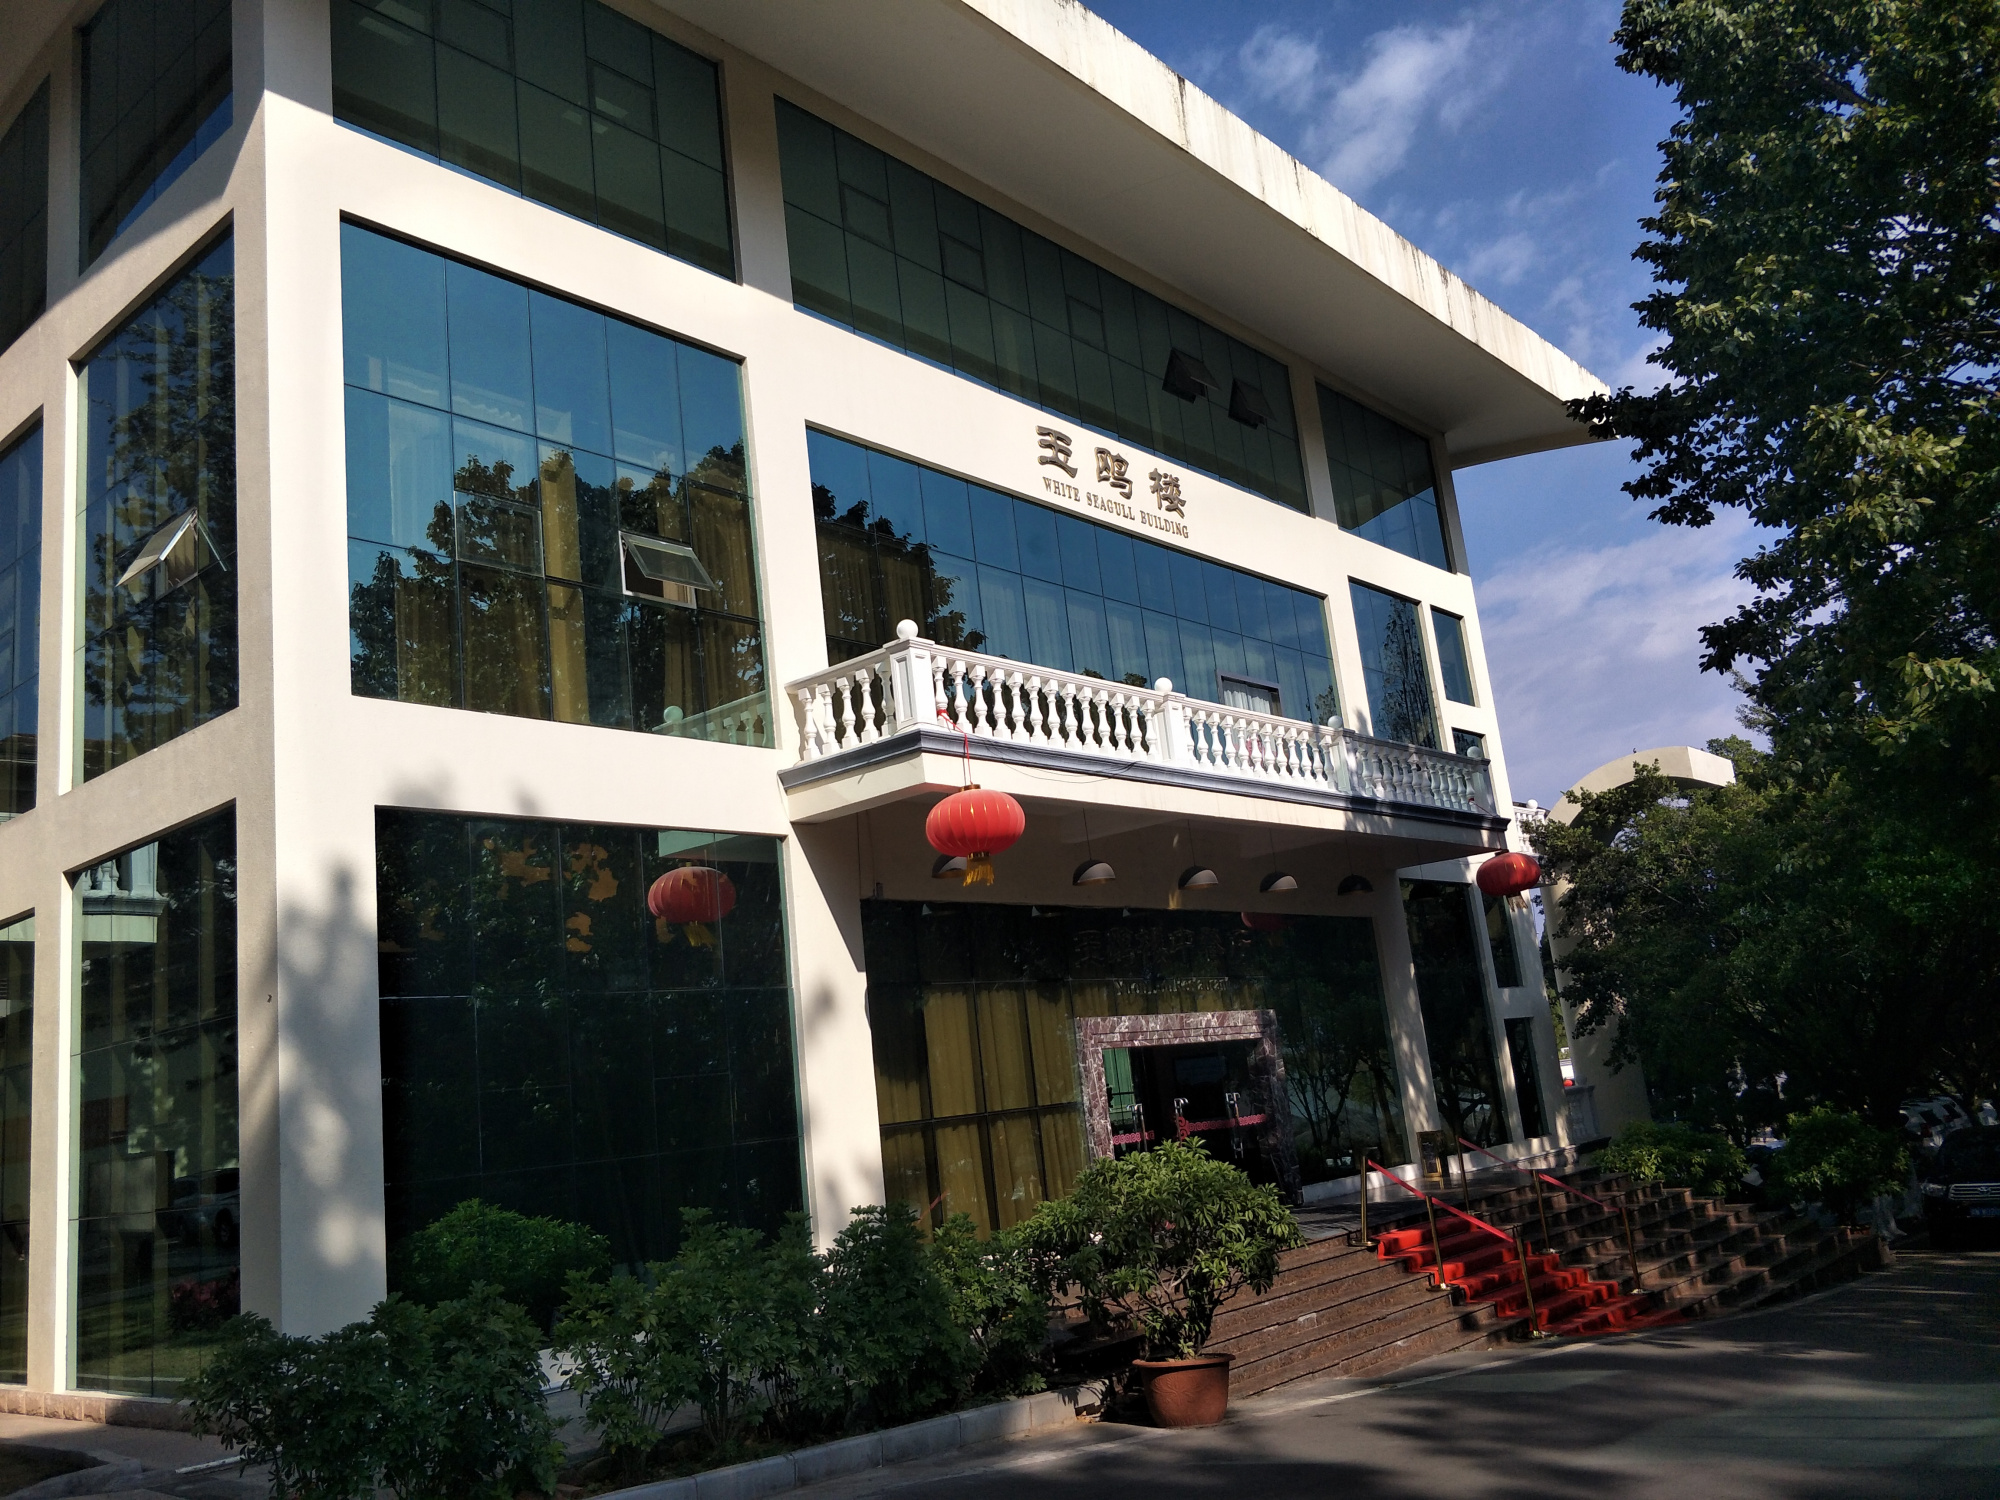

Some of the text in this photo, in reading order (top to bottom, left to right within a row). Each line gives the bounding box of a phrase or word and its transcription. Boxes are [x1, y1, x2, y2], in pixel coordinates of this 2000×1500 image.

[1042, 476, 1189, 539] WHITE SEAGULL BUILDING
